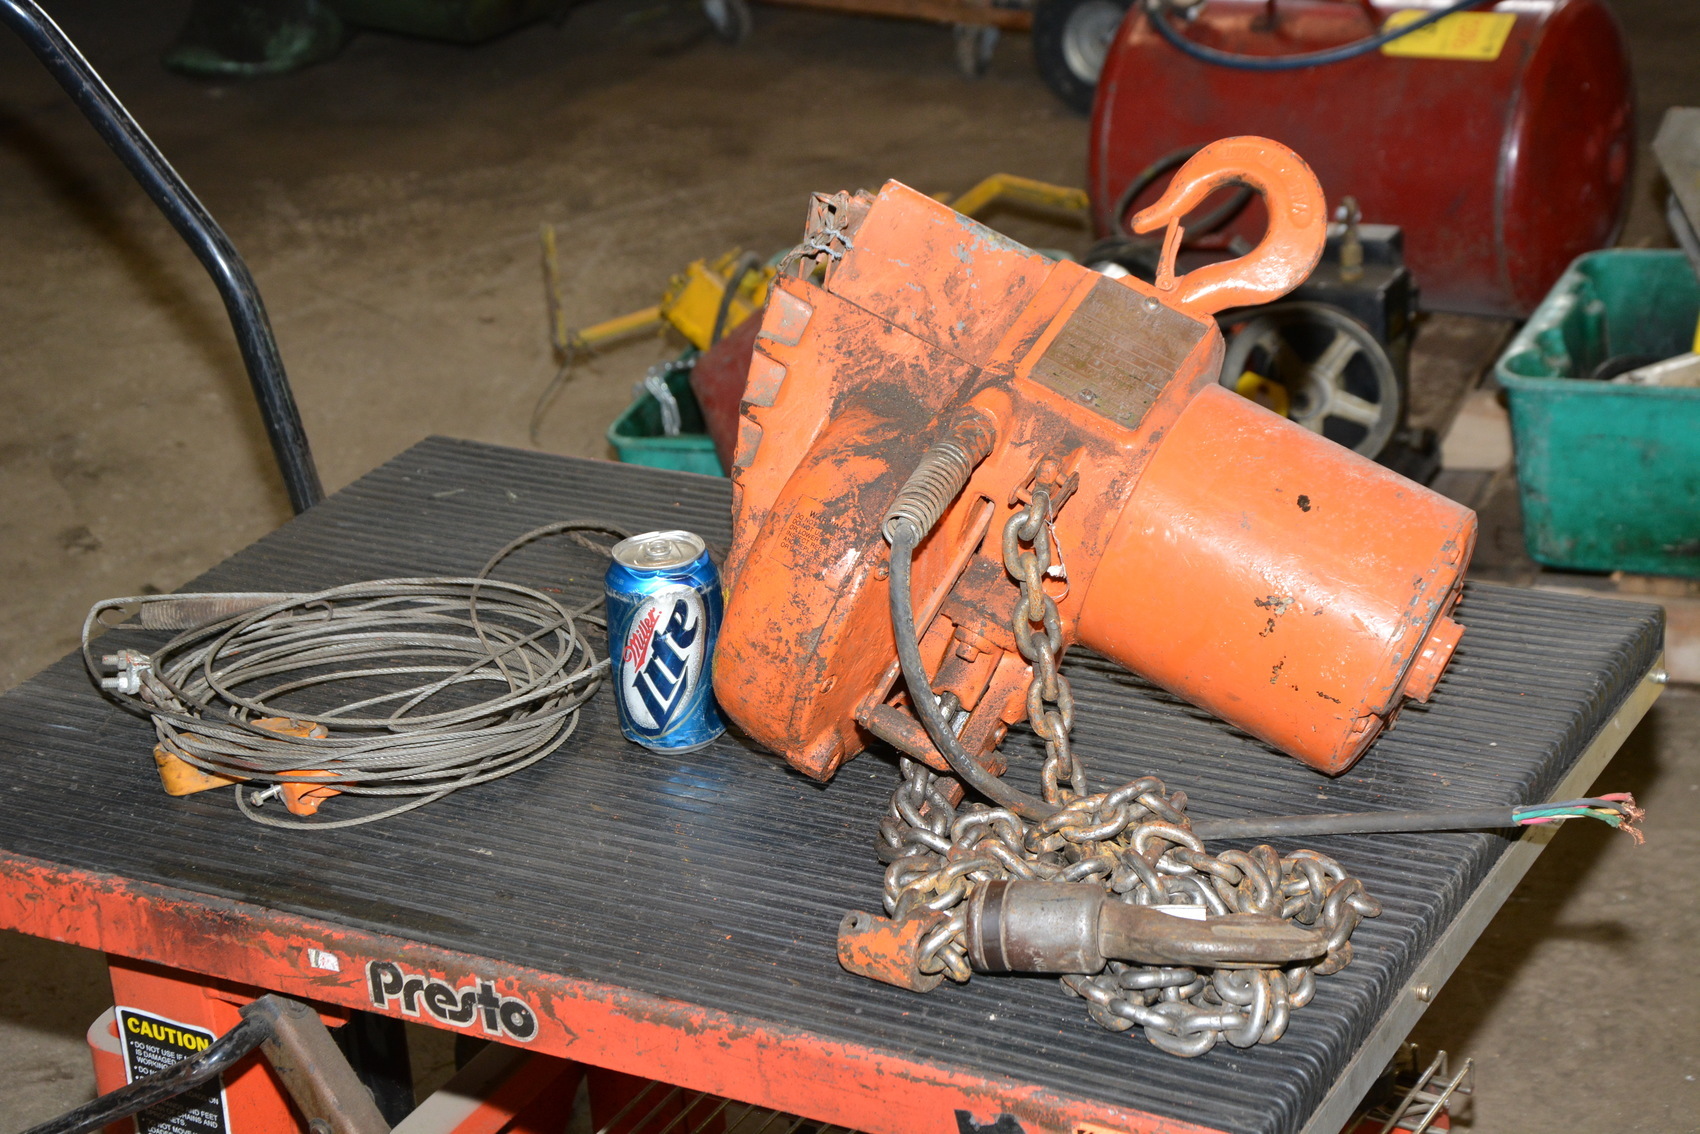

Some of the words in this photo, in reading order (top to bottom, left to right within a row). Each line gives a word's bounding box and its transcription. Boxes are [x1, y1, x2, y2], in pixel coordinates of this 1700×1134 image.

[623, 607, 658, 673] Miller
[632, 599, 698, 735] Lite
[365, 960, 539, 1042] Presto
[127, 1017, 209, 1052] CAUTION
[134, 1041, 145, 1050] DO
[145, 1045, 160, 1054] NOT
[161, 1049, 175, 1059] USE
[176, 1053, 183, 1061] IF
[135, 1048, 143, 1056] IS
[143, 1051, 177, 1066] DAMAGED
[138, 1065, 149, 1075] DO
[201, 1110, 218, 1121] FEET
[203, 1119, 218, 1129] AND
